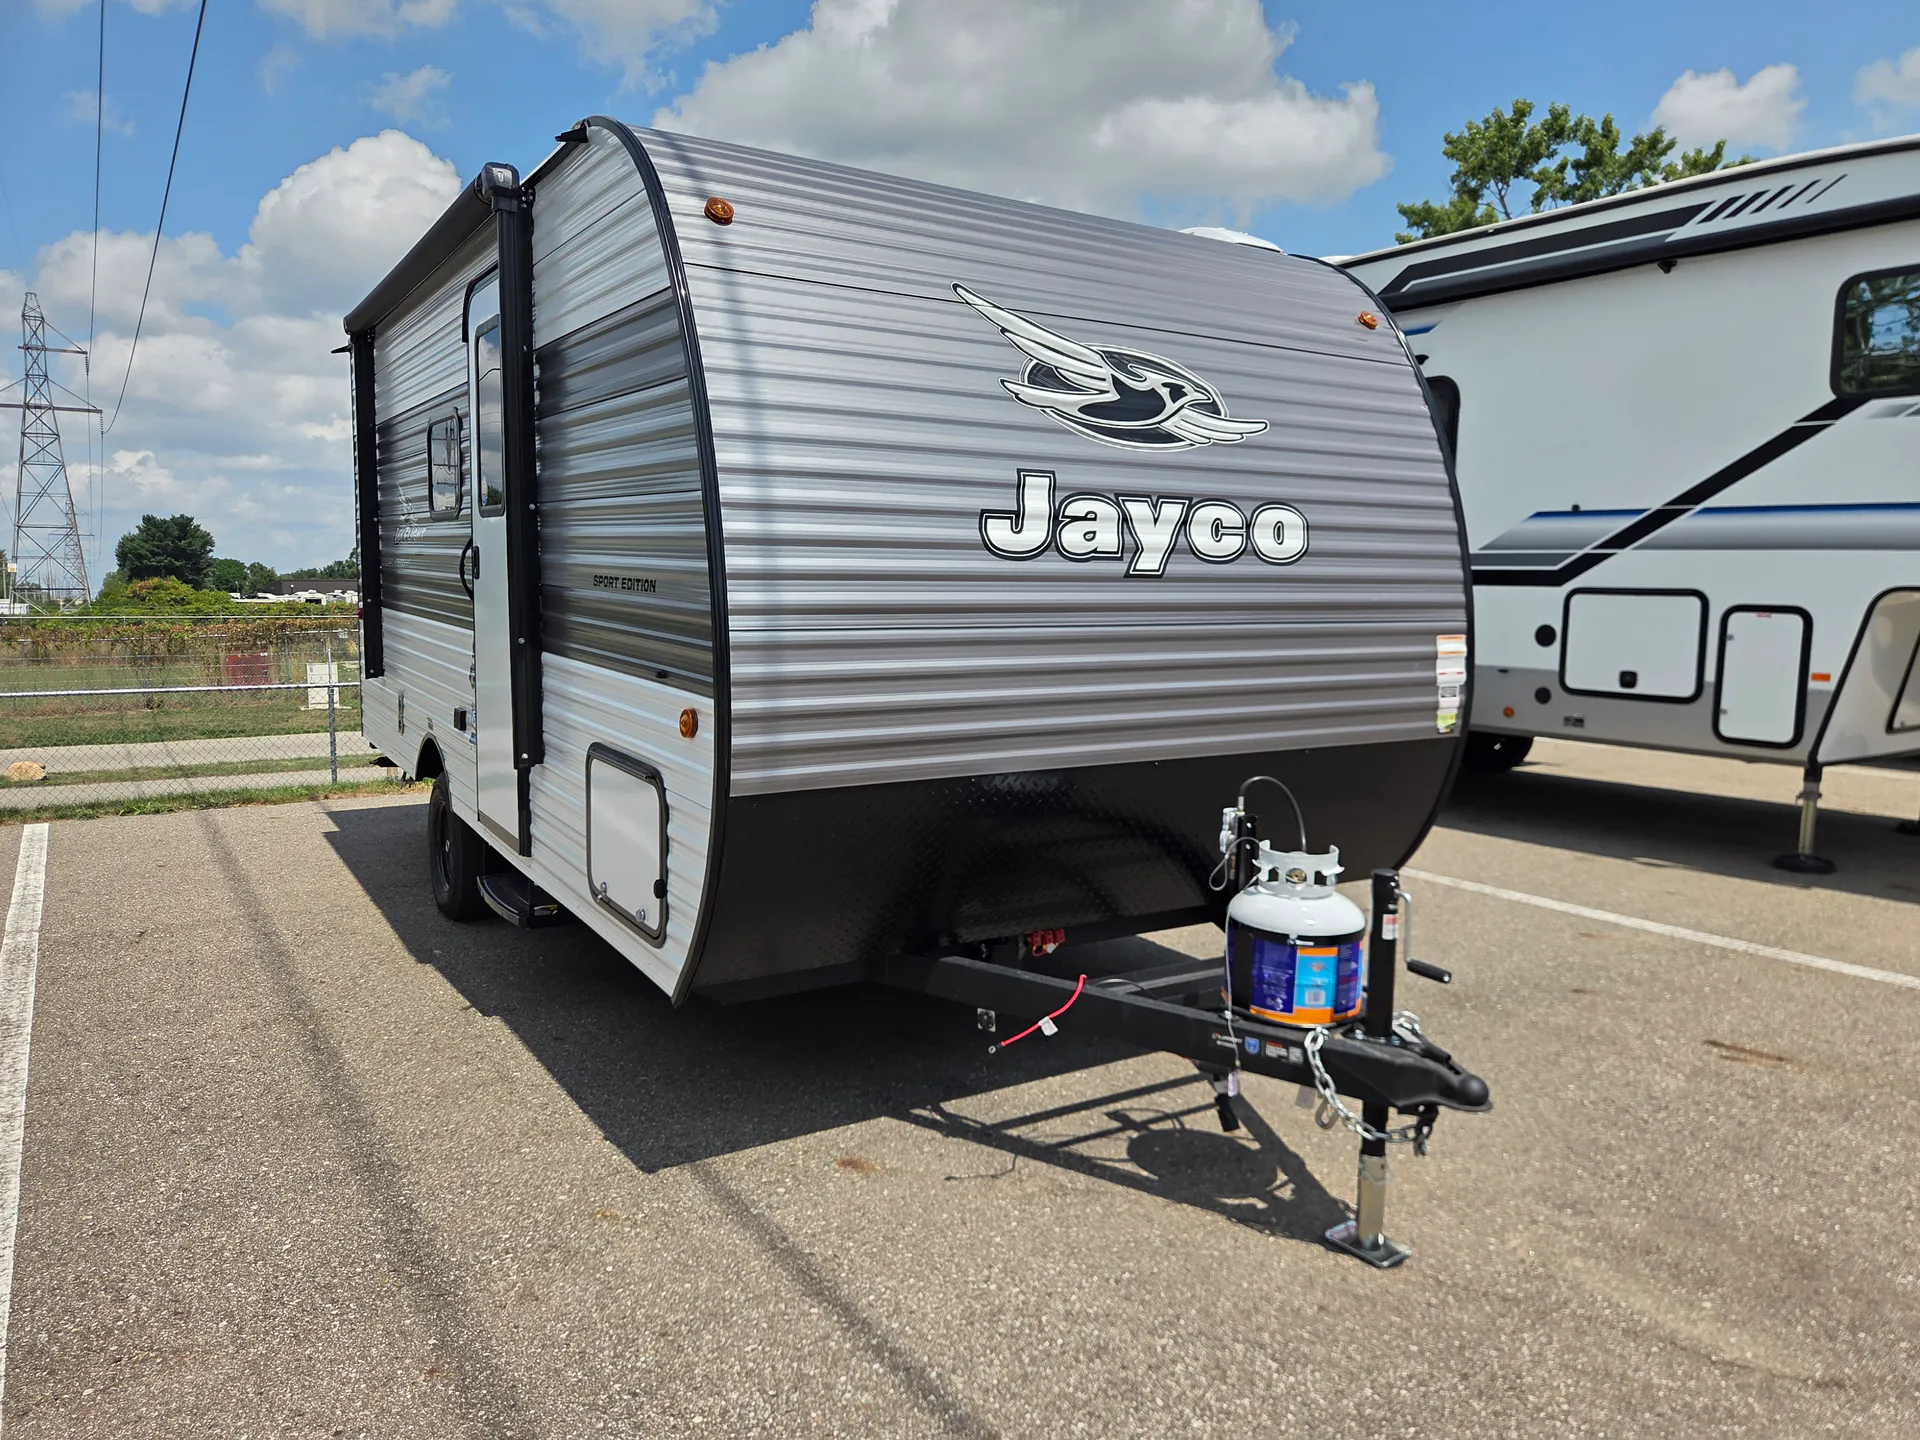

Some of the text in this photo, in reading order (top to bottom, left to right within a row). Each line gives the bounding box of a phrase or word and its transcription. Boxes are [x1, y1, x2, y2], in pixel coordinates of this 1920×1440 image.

[978, 468, 1309, 578] Jayco
[593, 574, 657, 593] SPORT EDITION
